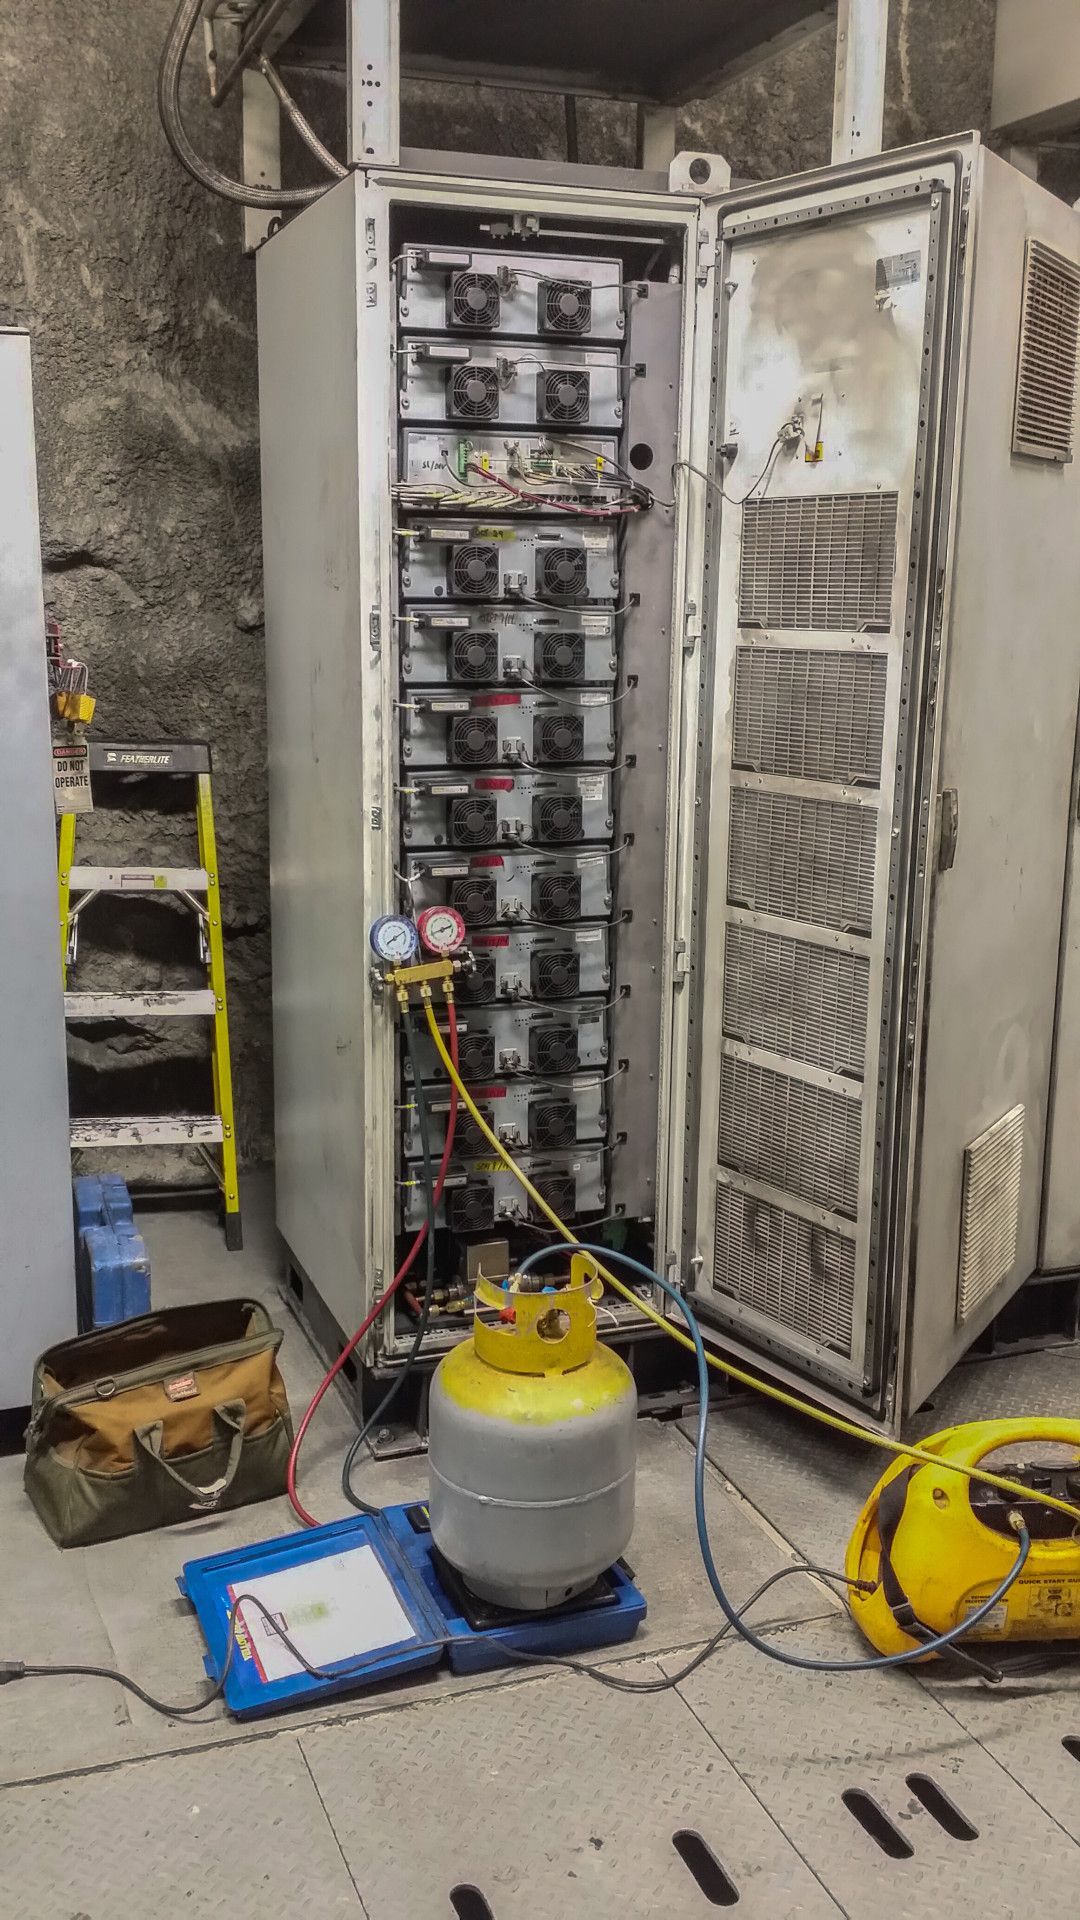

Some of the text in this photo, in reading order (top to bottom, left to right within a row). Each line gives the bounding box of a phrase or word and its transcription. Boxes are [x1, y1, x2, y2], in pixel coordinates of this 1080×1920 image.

[120, 755, 171, 764] FEATHERLITE
[57, 760, 85, 772] DO NOT
[55, 776, 89, 788] OPERATE
